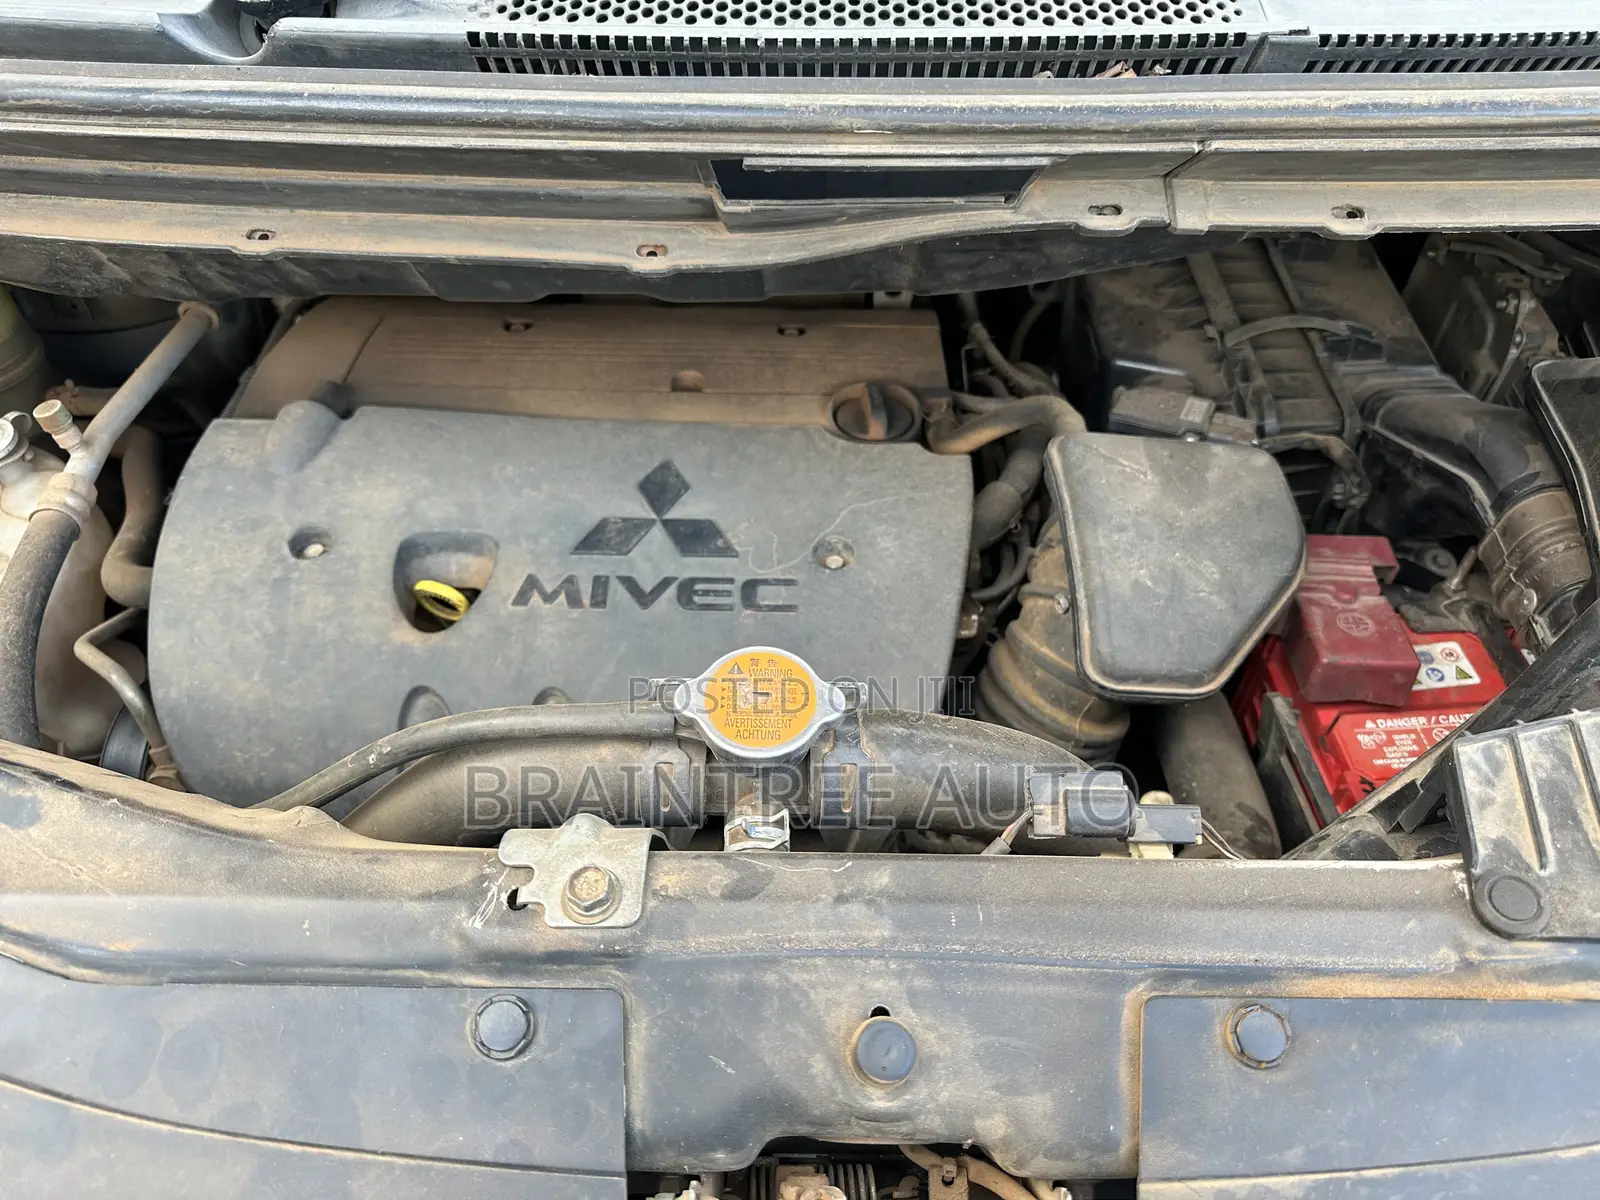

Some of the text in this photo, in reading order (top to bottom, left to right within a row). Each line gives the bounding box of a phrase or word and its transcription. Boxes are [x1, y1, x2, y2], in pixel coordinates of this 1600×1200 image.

[510, 573, 799, 612] MIVEC
[748, 669, 793, 678] WARNING
[724, 718, 793, 729] AVERTISSEMENT
[1376, 716, 1427, 728] DANGER
[735, 730, 781, 741] ACHTUNG
